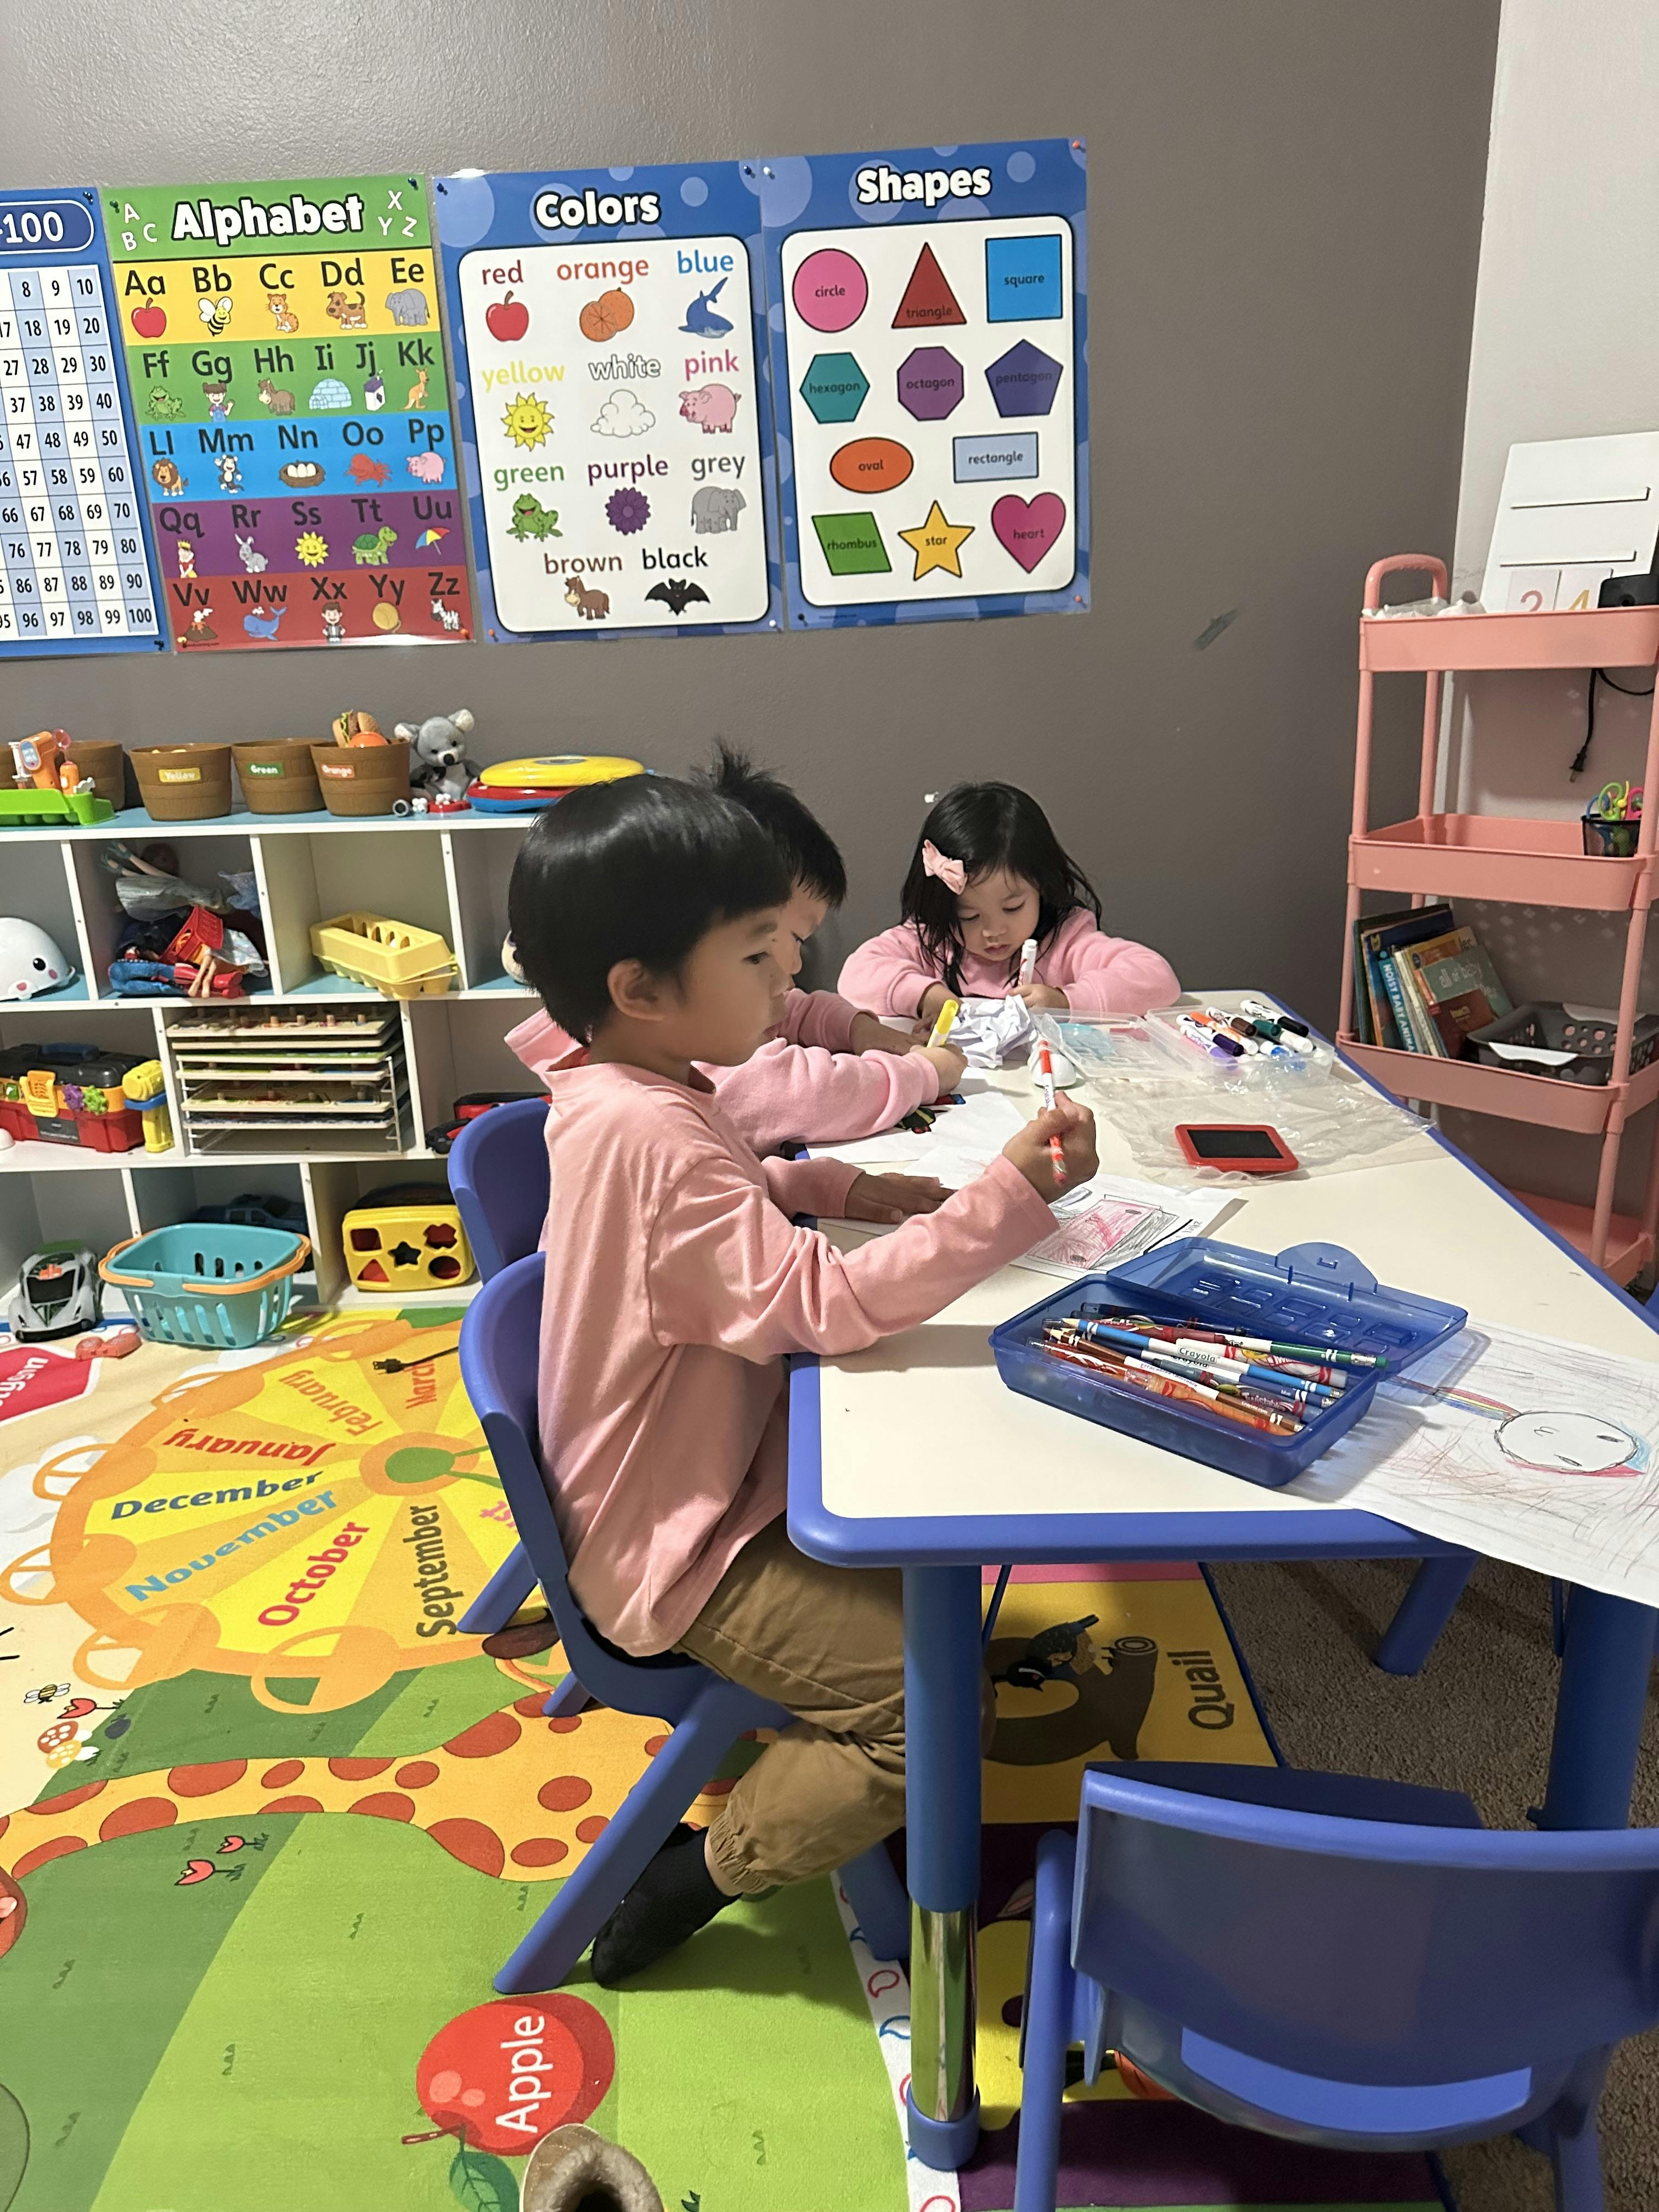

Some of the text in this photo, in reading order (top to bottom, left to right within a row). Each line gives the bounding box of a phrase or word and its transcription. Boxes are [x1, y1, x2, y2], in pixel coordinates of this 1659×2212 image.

[856, 165, 992, 207] Shapes
[387, 190, 403, 210] X
[534, 188, 660, 229] Colors
[124, 204, 139, 223] A
[172, 194, 364, 246] Alphabet
[122, 223, 157, 251] B C
[377, 216, 417, 238] Y Z
[125, 257, 425, 296] Aa Bb Cc Dd Ee
[482, 250, 733, 285] red orange blue
[22, 278, 93, 297] 8 9 10
[815, 285, 845, 298] circle
[1004, 274, 1045, 288] square
[906, 306, 952, 320] triangle
[25, 319, 42, 336] 18
[54, 318, 70, 335] 19
[83, 317, 100, 334] 20
[3, 356, 106, 376] 27 28 29 30
[143, 339, 435, 383] Ff Gg Hh Ii Jj Kk
[482, 349, 740, 392] yellow white pink
[809, 372, 1052, 396] hexagon octagon pentagon
[10, 393, 112, 413] 37 38 39 40
[16, 434, 31, 449] 47
[44, 432, 61, 448] 48
[73, 431, 89, 447] 49
[101, 430, 117, 445] 50
[150, 419, 445, 456] Ll Mm Nn Oo Pp
[494, 454, 746, 491] green purple grey
[859, 452, 1023, 472] oval rectangle
[0, 466, 124, 487] 6 57 58 59 60
[2, 503, 130, 522] 66 67 68 69 70
[160, 496, 452, 538] Qq Rr Ss Tt Uu
[9, 538, 137, 558] 76 77 78 79 80
[827, 528, 1045, 550] rhombus star heart
[544, 546, 709, 575] brown black
[16, 578, 32, 593] 86
[44, 577, 59, 592] 87
[71, 576, 88, 591] 88
[99, 575, 115, 590] 89
[127, 573, 143, 589] 90
[173, 572, 460, 606] Vv Ww Xx Yy Zz
[22, 613, 38, 628] 96
[50, 612, 65, 627] 97
[77, 611, 94, 625] 98
[105, 610, 120, 624] 99
[129, 608, 151, 623] 100
[164, 771, 195, 780] Yellow
[251, 765, 278, 774] Green
[1179, 1347, 1216, 1363] Crayola
[279, 1370, 383, 1436] February
[164, 1427, 337, 1469] January
[110, 1470, 324, 1520] December
[124, 1489, 338, 1603] November
[257, 1522, 370, 1628] October
[403, 1504, 464, 1639] September
[1166, 1650, 1234, 1730] Quail
[495, 2016, 554, 2133] Apple
